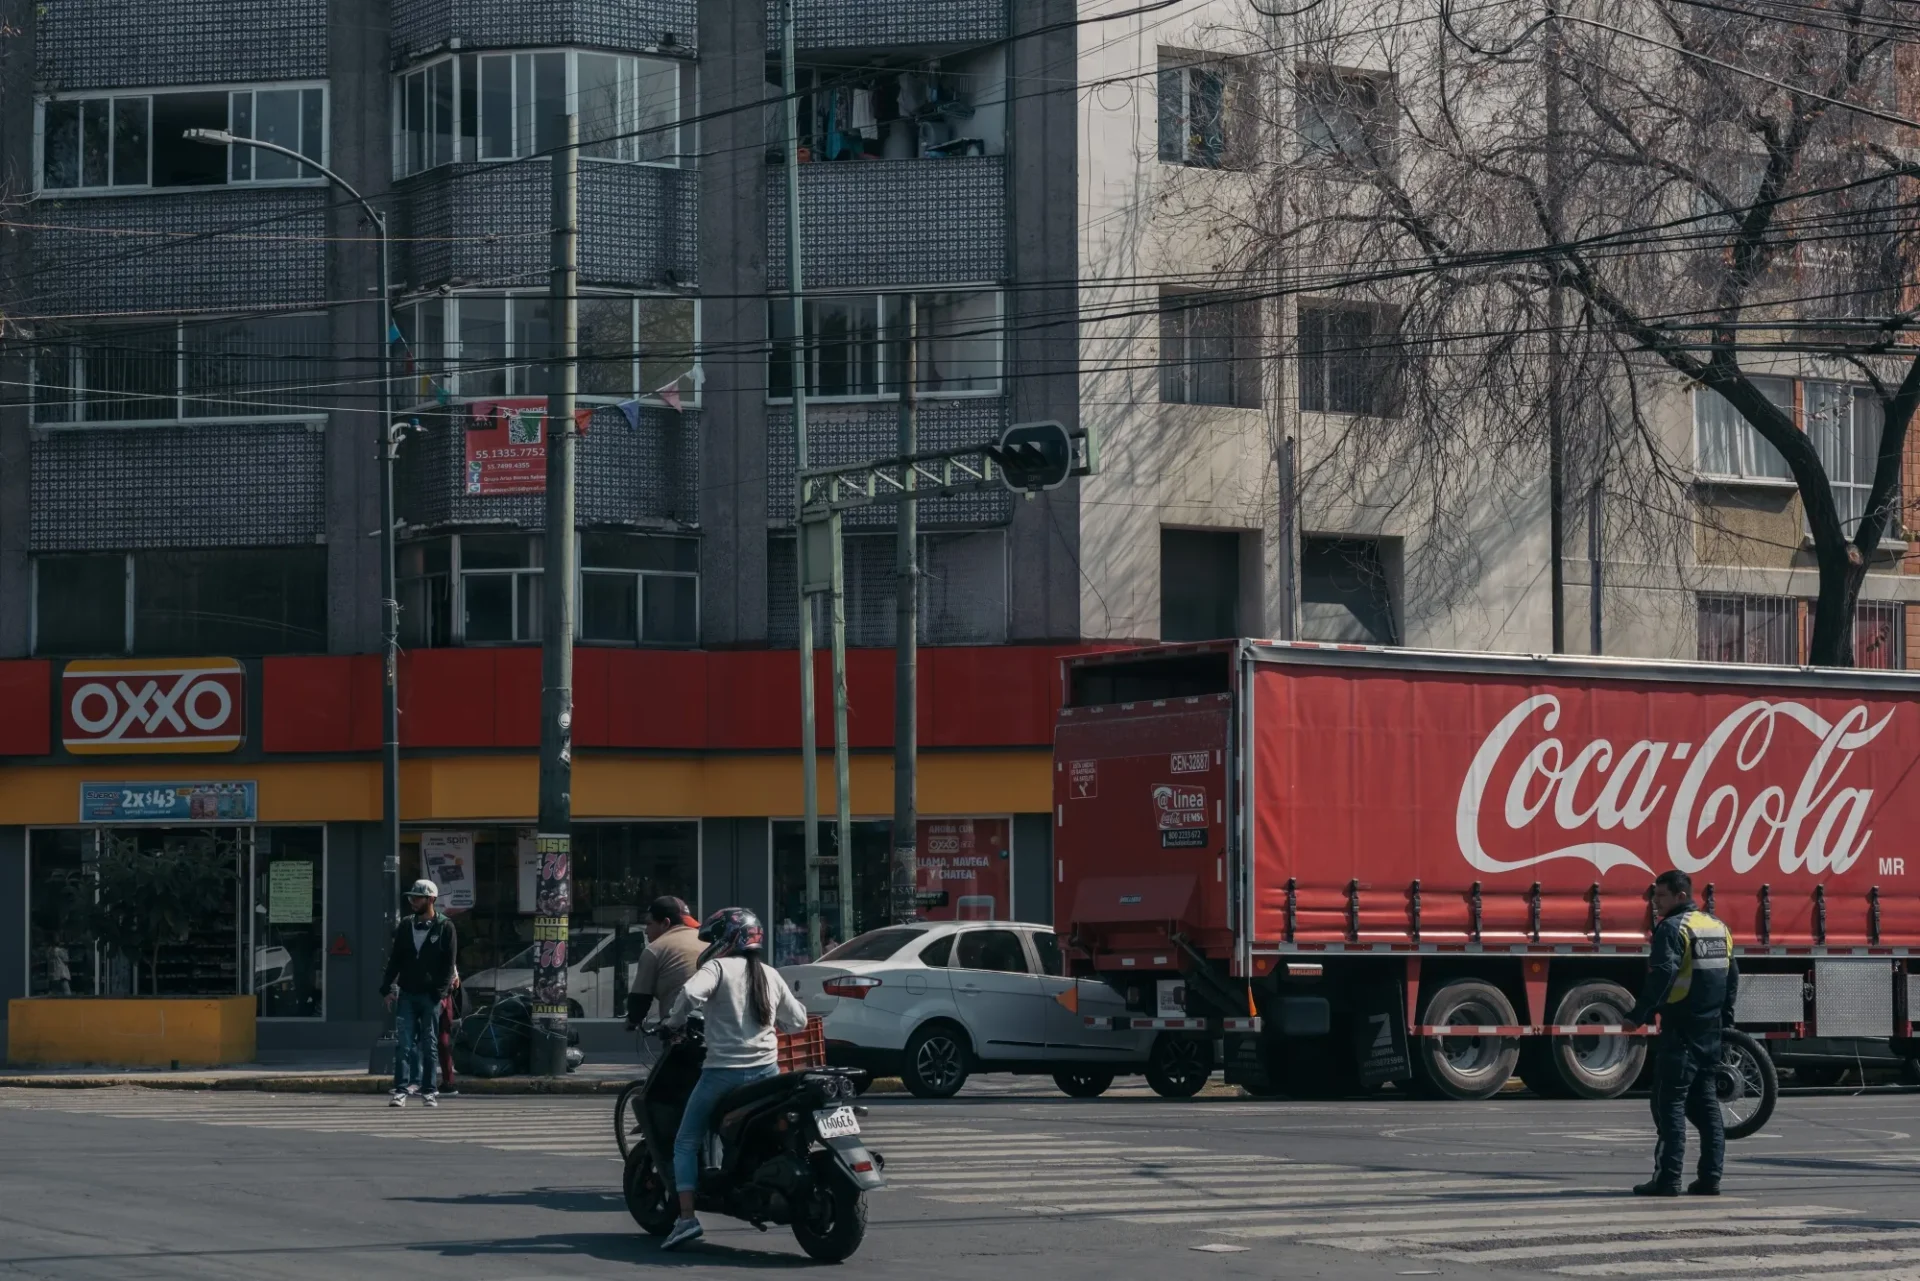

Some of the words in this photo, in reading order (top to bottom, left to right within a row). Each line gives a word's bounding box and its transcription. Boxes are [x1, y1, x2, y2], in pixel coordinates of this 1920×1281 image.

[475, 447, 545, 459] 55.1335.7752
[71, 678, 232, 737] OXXO
[1455, 693, 1896, 876] Coca-Cola
[1173, 788, 1204, 809] línea
[928, 825, 956, 834] AHORA
[958, 824, 974, 833] CON
[446, 834, 469, 846] spin
[929, 839, 958, 850] OXXO
[542, 852, 567, 880] 70
[917, 856, 950, 869] LLAMA,
[952, 856, 989, 867] NAVEGA
[1879, 857, 1905, 876] MR
[929, 869, 937, 879] Y
[939, 869, 976, 880] CHATEA!
[541, 940, 566, 968] 70
[820, 1115, 854, 1130] 1606E6
